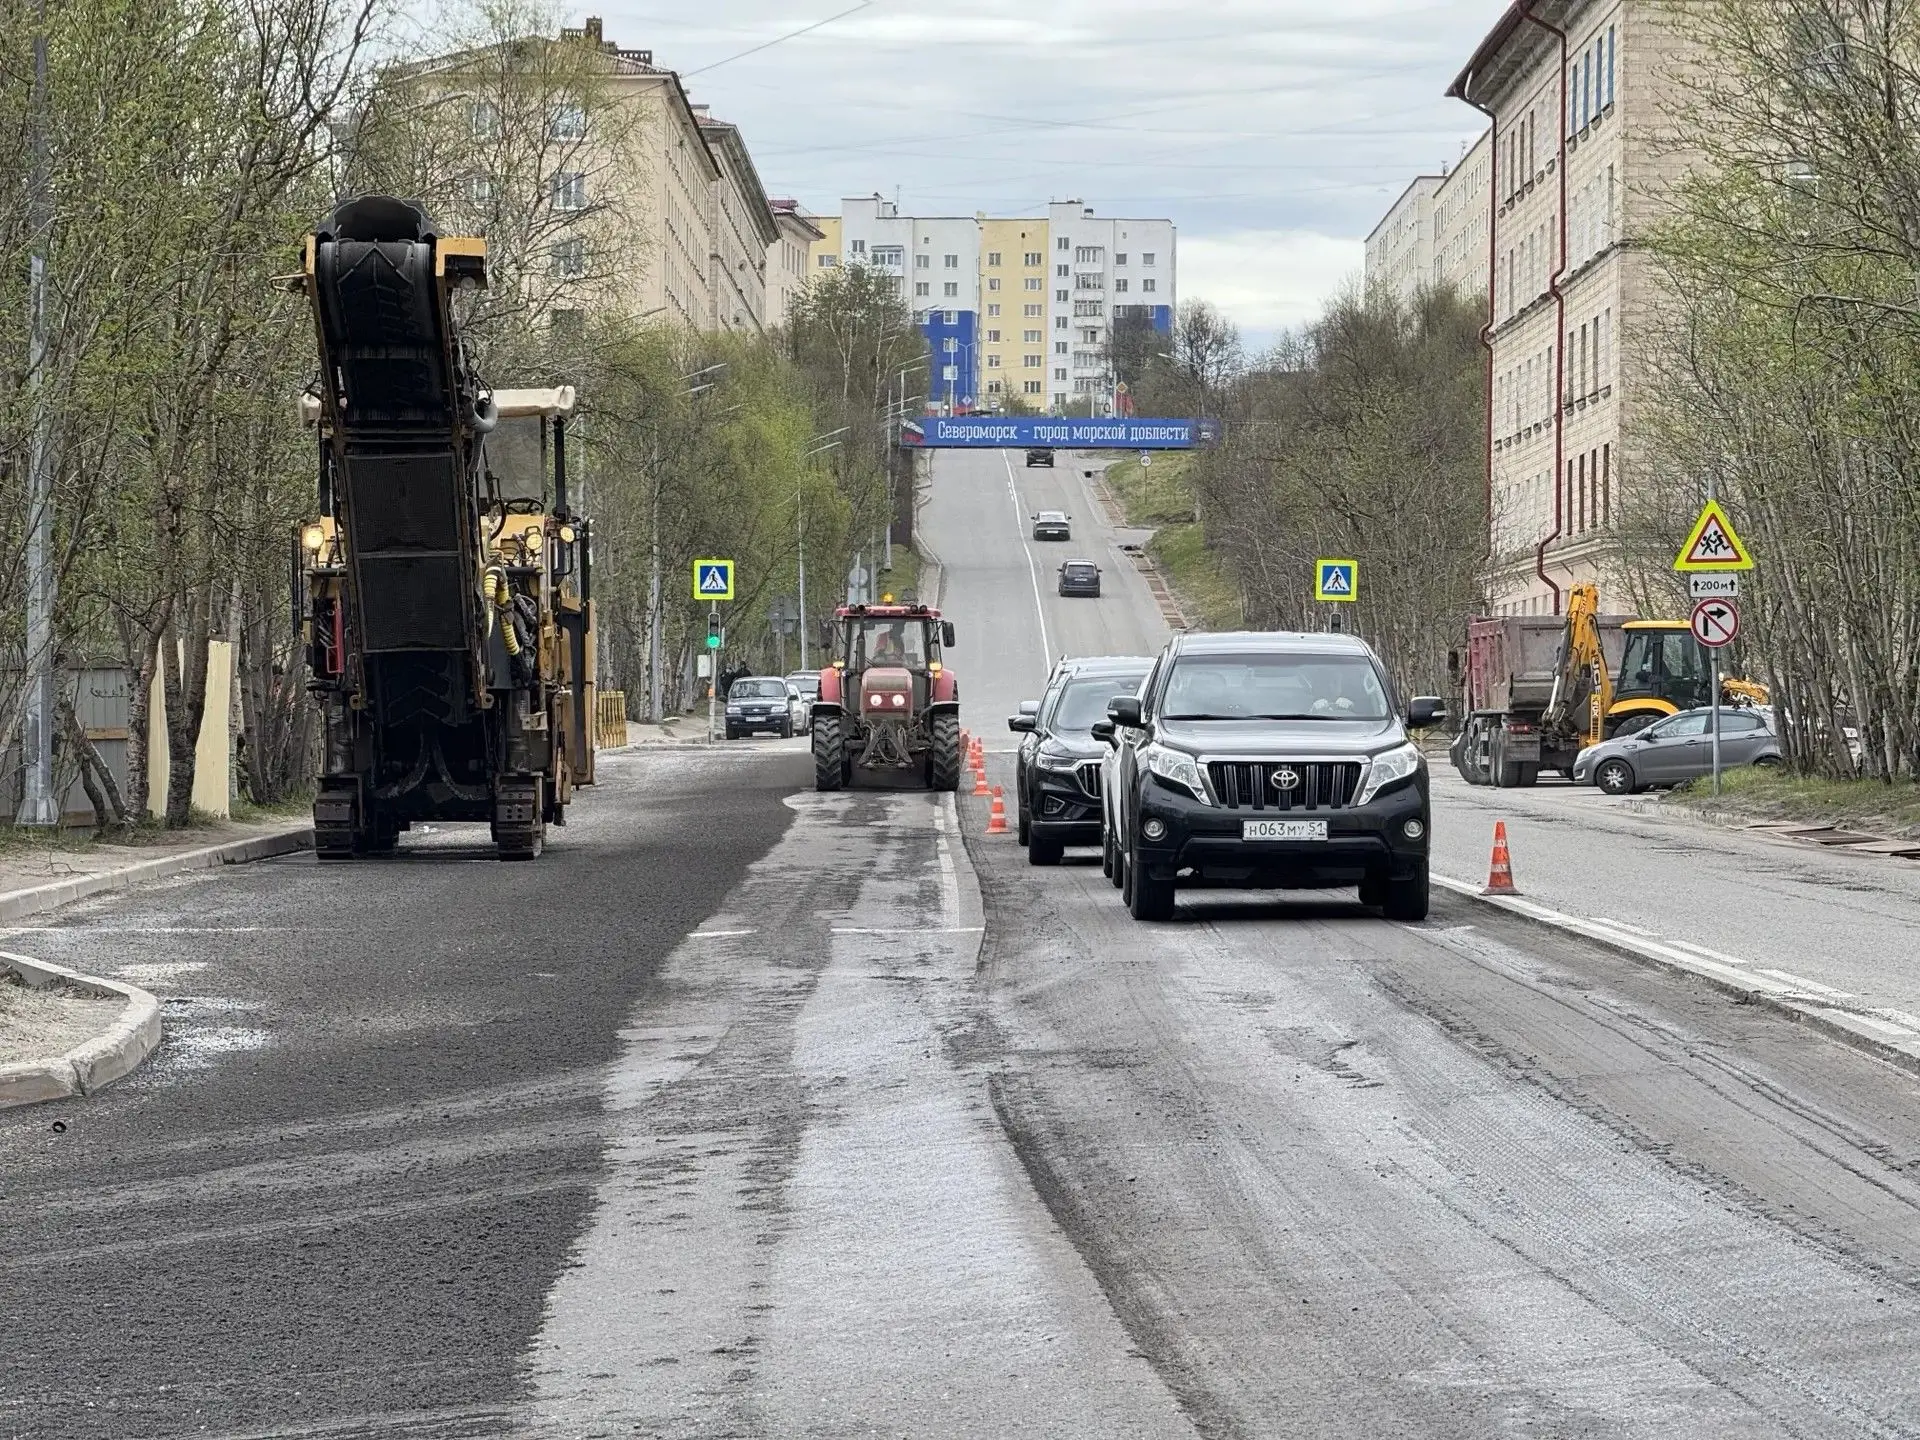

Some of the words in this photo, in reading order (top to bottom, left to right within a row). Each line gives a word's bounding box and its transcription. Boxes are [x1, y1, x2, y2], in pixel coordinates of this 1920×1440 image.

[938, 421, 1017, 442] Североморск
[1033, 425, 1069, 442] город
[1073, 423, 1126, 443] морской
[1130, 425, 1189, 442] доблести
